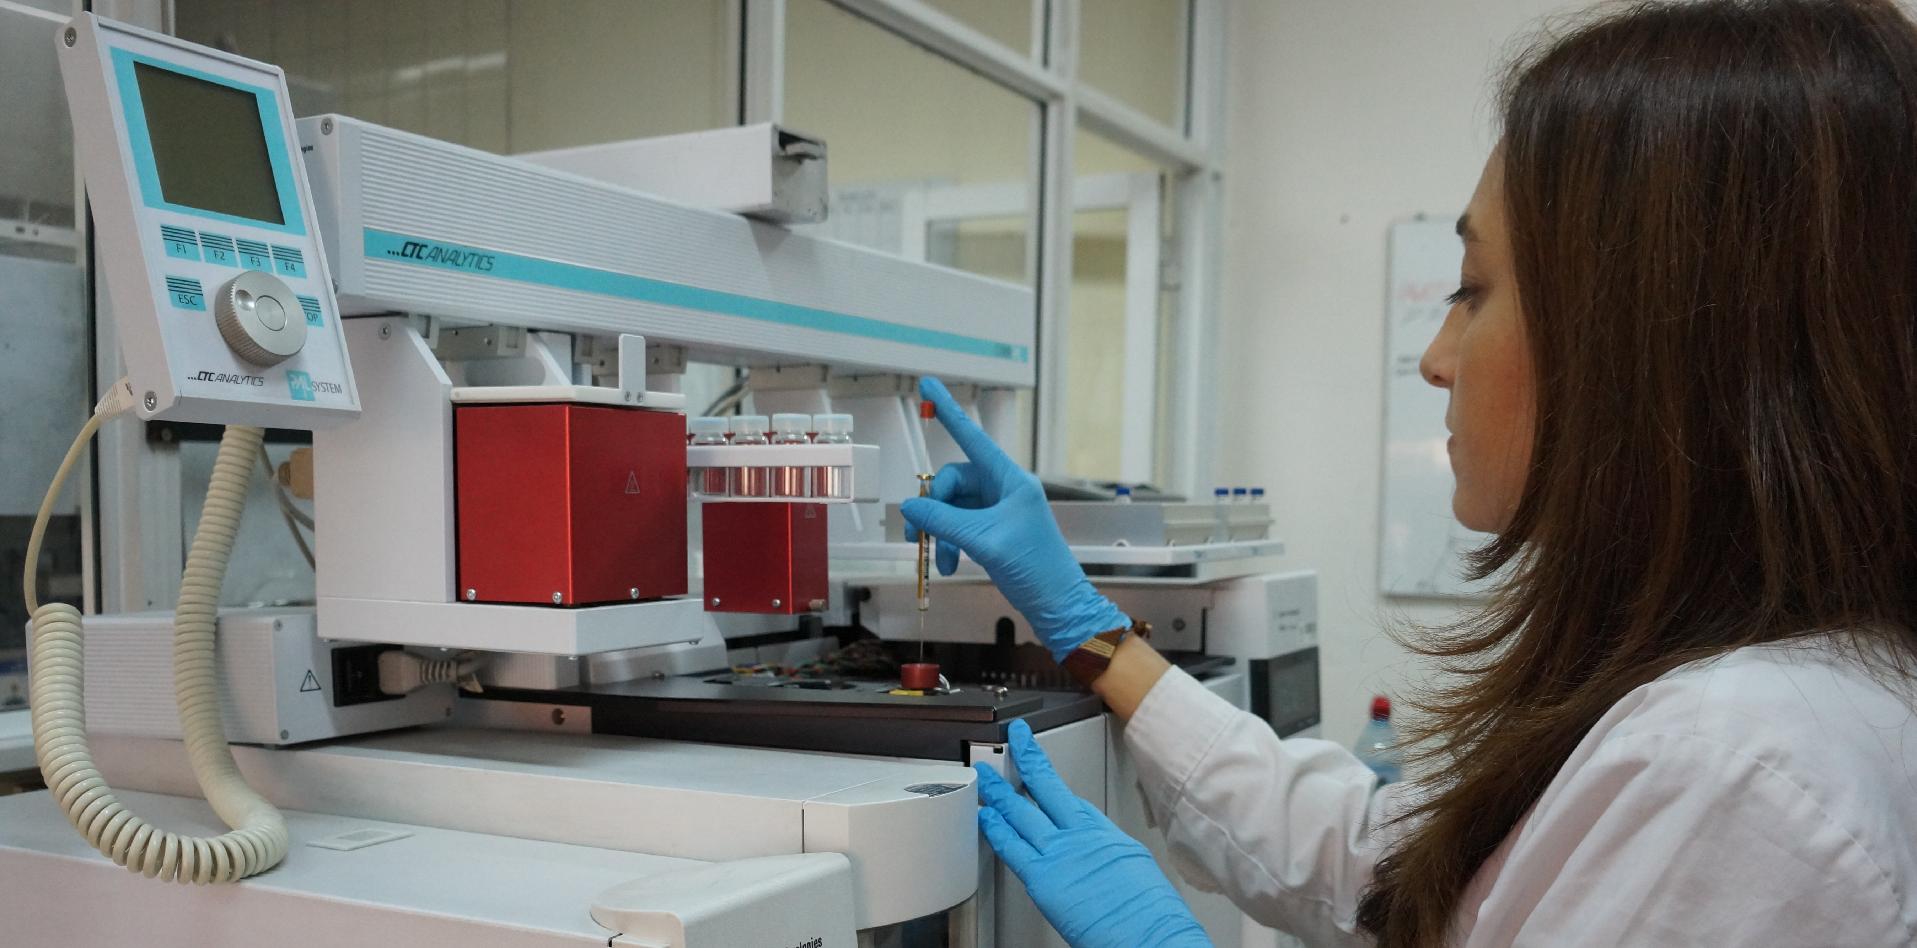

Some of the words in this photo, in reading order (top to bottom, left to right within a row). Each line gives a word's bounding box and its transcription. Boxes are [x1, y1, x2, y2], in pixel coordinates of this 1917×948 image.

[176, 243, 187, 254] F1
[214, 249, 225, 260] F2
[425, 246, 495, 271] ANALYTICS
[251, 256, 261, 267] F3
[285, 262, 296, 272] F4
[179, 295, 198, 306] ESC
[215, 374, 264, 387] ANALYTICS
[312, 381, 343, 394] SYSTEM
